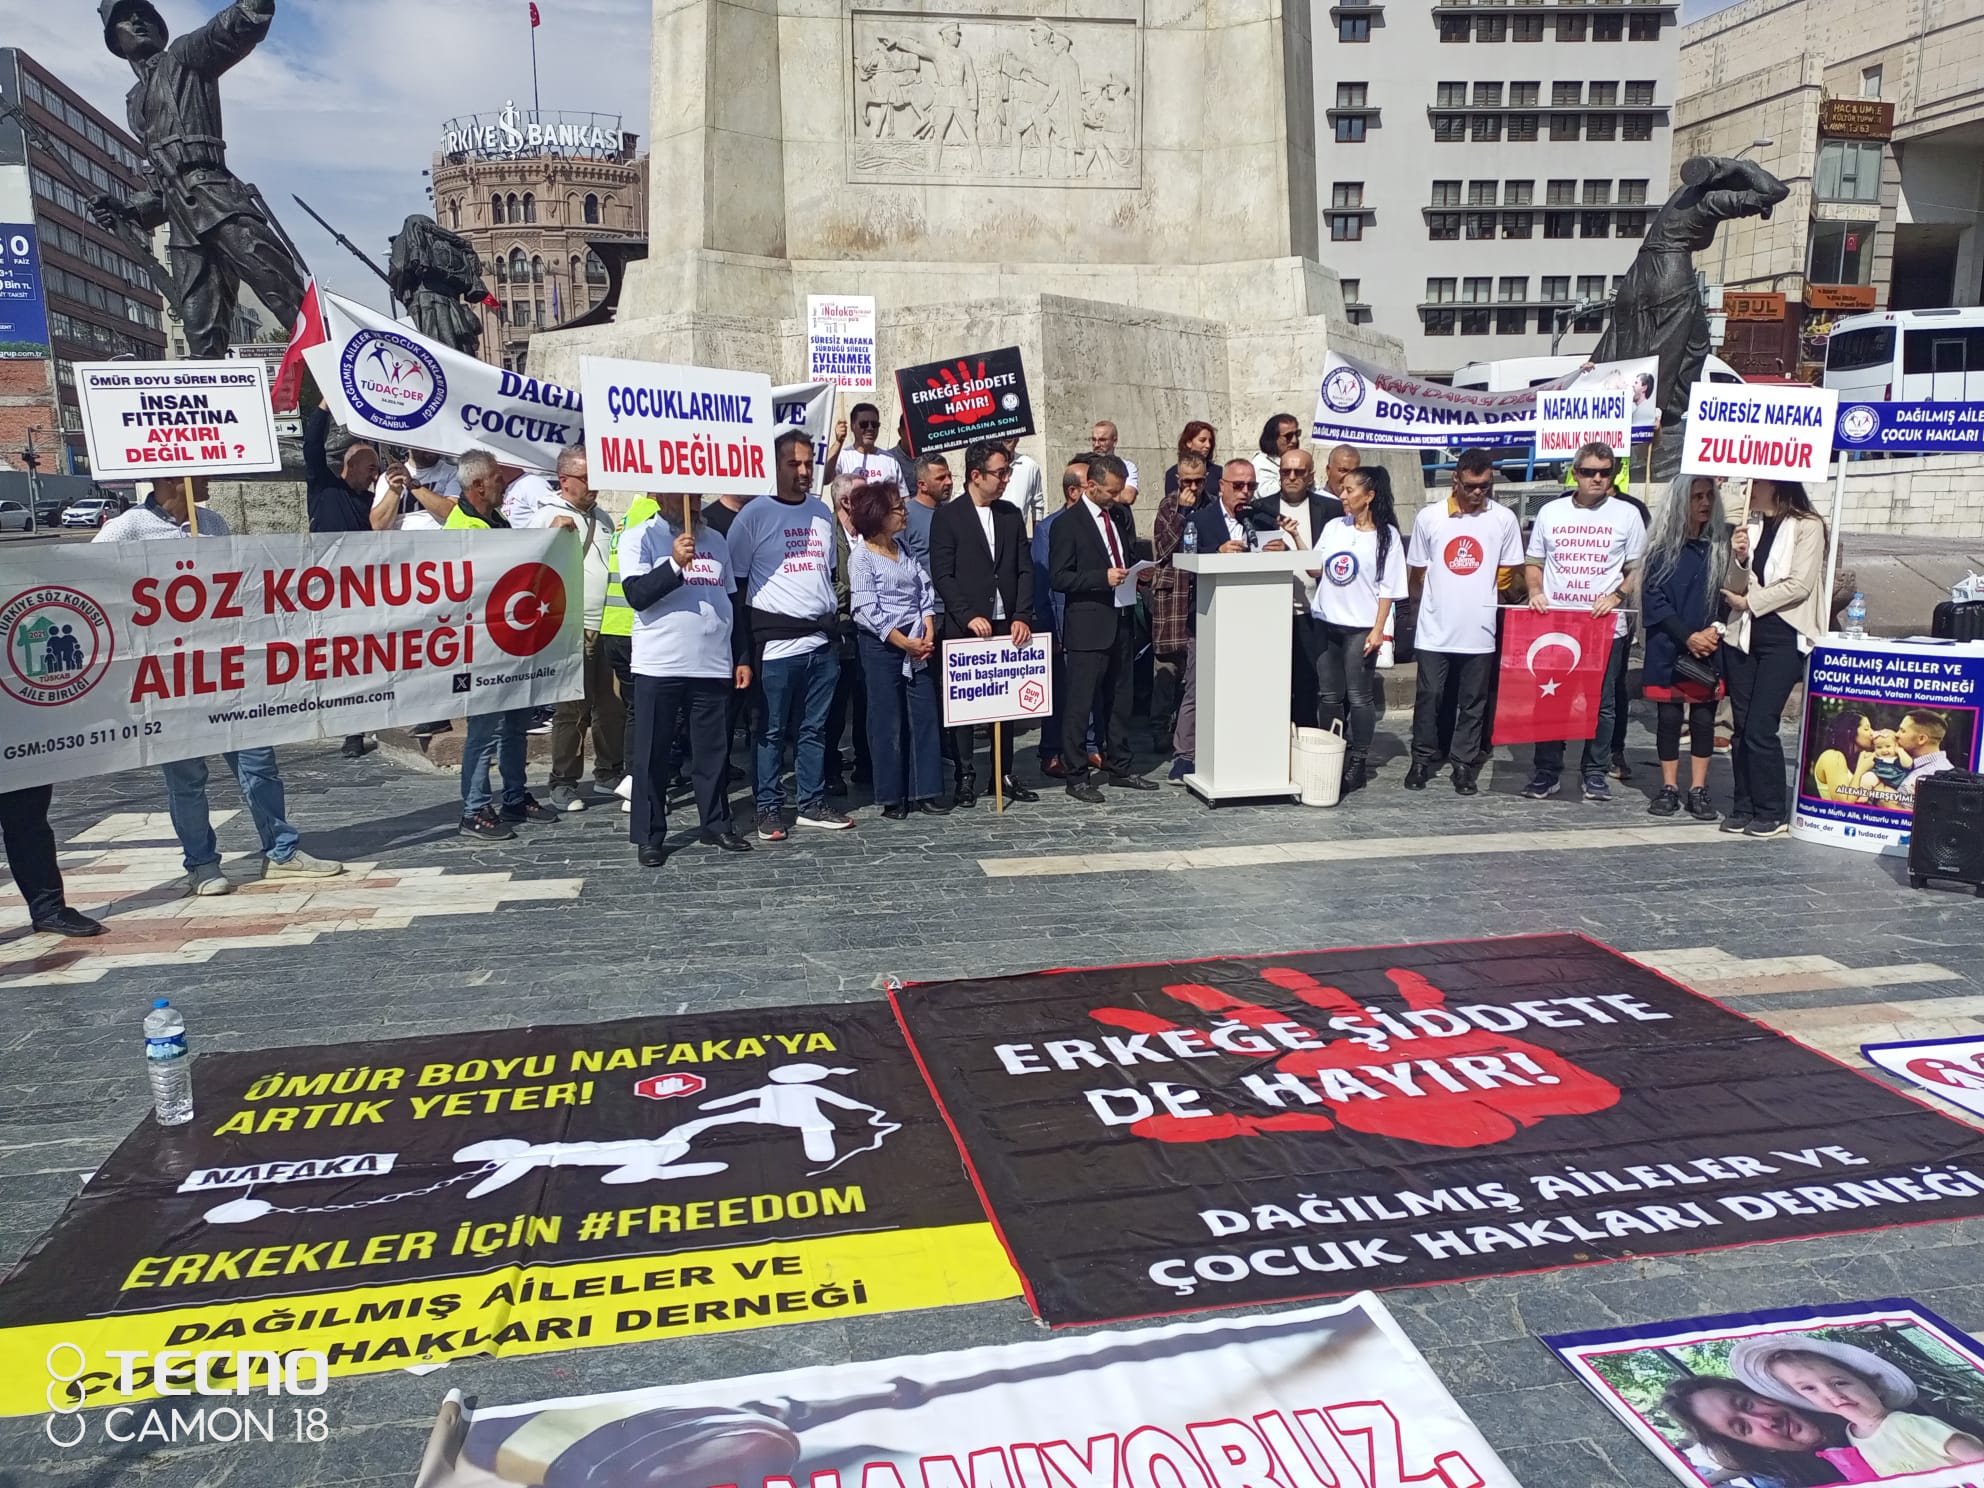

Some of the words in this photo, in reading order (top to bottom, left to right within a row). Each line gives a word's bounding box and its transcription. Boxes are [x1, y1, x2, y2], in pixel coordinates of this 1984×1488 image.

[441, 123, 497, 155] TÜRKİYE
[528, 124, 624, 151] BANKASI
[346, 332, 372, 362] AİLELER
[384, 333, 422, 354] ÇOCUK
[810, 335, 840, 344] SÜRESİZ
[843, 337, 873, 345] NAFAKA
[815, 344, 845, 352] SÜRDÜĞÜ
[846, 345, 869, 353] SÜRECE
[812, 353, 871, 364] EVLENMEK
[90, 375, 131, 386] ÖMÜR
[134, 375, 170, 386] BOYU
[174, 374, 217, 385] SÜREN
[221, 375, 256, 386] BORÇ
[812, 364, 871, 375] APTALLIKTIR
[361, 380, 424, 401] TÜDAÇ-DER
[855, 377, 872, 387] SON
[912, 383, 961, 405] ERKEĞE
[962, 372, 1017, 397] ŞİDDETE
[140, 392, 208, 411] İNSAN
[608, 385, 753, 424] ÇOCUKLARIMIZ
[945, 395, 990, 415] HAYIR!
[1543, 397, 1589, 421] NAFAKA
[1592, 391, 1625, 419] HAPSİ
[1699, 396, 1761, 424] SÜRESİZ
[1764, 404, 1822, 427] NAFAKA
[122, 410, 238, 427] FITRATINA
[370, 413, 411, 429] İSTANBUL
[1376, 400, 1480, 426] BOŞANMA
[1896, 408, 1955, 426] DAĞILMIŞ
[147, 426, 220, 443] AYKIRI
[460, 404, 571, 445] ÇOCUK
[928, 426, 956, 441] ÇOCUK
[957, 420, 996, 434] İCRASINA
[997, 416, 1019, 427] SON!
[1541, 428, 1581, 450] İNSANLIK
[1881, 429, 1923, 444] ÇOCUK
[1926, 429, 1978, 442] HAKLARI
[126, 442, 194, 463] DEĞİL
[202, 442, 227, 460] Mİ
[234, 444, 246, 458] ?
[601, 436, 653, 474] MAL
[661, 433, 766, 479] DEĞİLDİR
[1698, 434, 1813, 468] ZULÜMDÜR
[784, 527, 818, 538] BABAYI
[1552, 526, 1613, 536] KADINDAN
[1555, 538, 1611, 549] SORUMLU
[783, 561, 816, 574] SİLME.
[1554, 552, 1609, 563] ERKEKTEN
[131, 559, 244, 627] SÖZ
[263, 560, 474, 614] KONUSU
[1566, 580, 1591, 590] AİLE
[0, 596, 36, 636] TÜRKİYE
[37, 590, 61, 603] SÖZ
[64, 593, 105, 628] KONUSU
[130, 637, 245, 703] AİLE
[265, 613, 474, 686] DERNEĞİ
[949, 651, 997, 668] Süresiz
[1001, 647, 1045, 664] Nafaka
[1824, 653, 1883, 672] DAĞILMIŞ
[1885, 657, 1939, 674] AİLELER
[1943, 663, 1962, 676] VE
[475, 667, 556, 687] SozKonusuAile
[949, 669, 972, 682] Yeni
[975, 664, 1046, 682] başlangıçlara
[1813, 670, 1850, 684] ÇOCUK
[1854, 673, 1909, 690] HAKLARI
[1914, 678, 1975, 694] DERNEĞİ
[19, 686, 45, 701] AİLE
[48, 677, 90, 701] BİRLİĞİ
[950, 681, 1009, 702] Engeldir!
[1025, 687, 1040, 698] DUR
[1823, 684, 1844, 695] Aileyi
[1845, 686, 1883, 698] Korumak,
[1885, 690, 1912, 700] Vatanı
[1914, 693, 1966, 704] Korumaktır.
[208, 690, 396, 725] www.ailemedokunma.com
[4, 734, 85, 760] GSM:0530
[90, 729, 116, 745] 511
[122, 725, 138, 740] 01
[144, 721, 162, 736] 52
[1836, 785, 1869, 797] AİLEMİZ
[1869, 790, 1915, 803] HERŞEYİMİ
[1827, 807, 1847, 818] Mutlu
[1862, 813, 1890, 824] Huzurlu
[1857, 828, 1889, 841] tudacder
[993, 1019, 1327, 1075] ERKEĞE
[1330, 993, 1672, 1053] ŞİDDETE
[243, 1066, 402, 1102] ÖMÜR
[415, 1055, 556, 1088] BOYU
[571, 1031, 837, 1074] NAFAKA'YA
[1083, 1080, 1213, 1127] DE
[1241, 1051, 1561, 1108] HAYIR!
[213, 1097, 389, 1137] ARTIK
[410, 1081, 595, 1121] YETER!
[199, 1155, 378, 1186] NAFAKA
[1199, 1181, 1521, 1237] DAĞILMIŞ
[1530, 1155, 1782, 1202] AİLELER
[1769, 1145, 1870, 1170] VE
[120, 1230, 437, 1292] ERKEKLER
[451, 1213, 561, 1259] İÇİN
[577, 1185, 867, 1242] #FREEDOM
[1149, 1238, 1405, 1296] ÇOCUK
[1411, 1201, 1723, 1261] HAKLARI
[1717, 1165, 1984, 1222] DERNEĞİ
[165, 1292, 462, 1347] DAĞILMIŞ
[480, 1266, 714, 1310] AİLELER
[732, 1256, 805, 1278] VE
[327, 1315, 592, 1366] HAKLARI
[616, 1280, 868, 1333] DERNEĞİ
